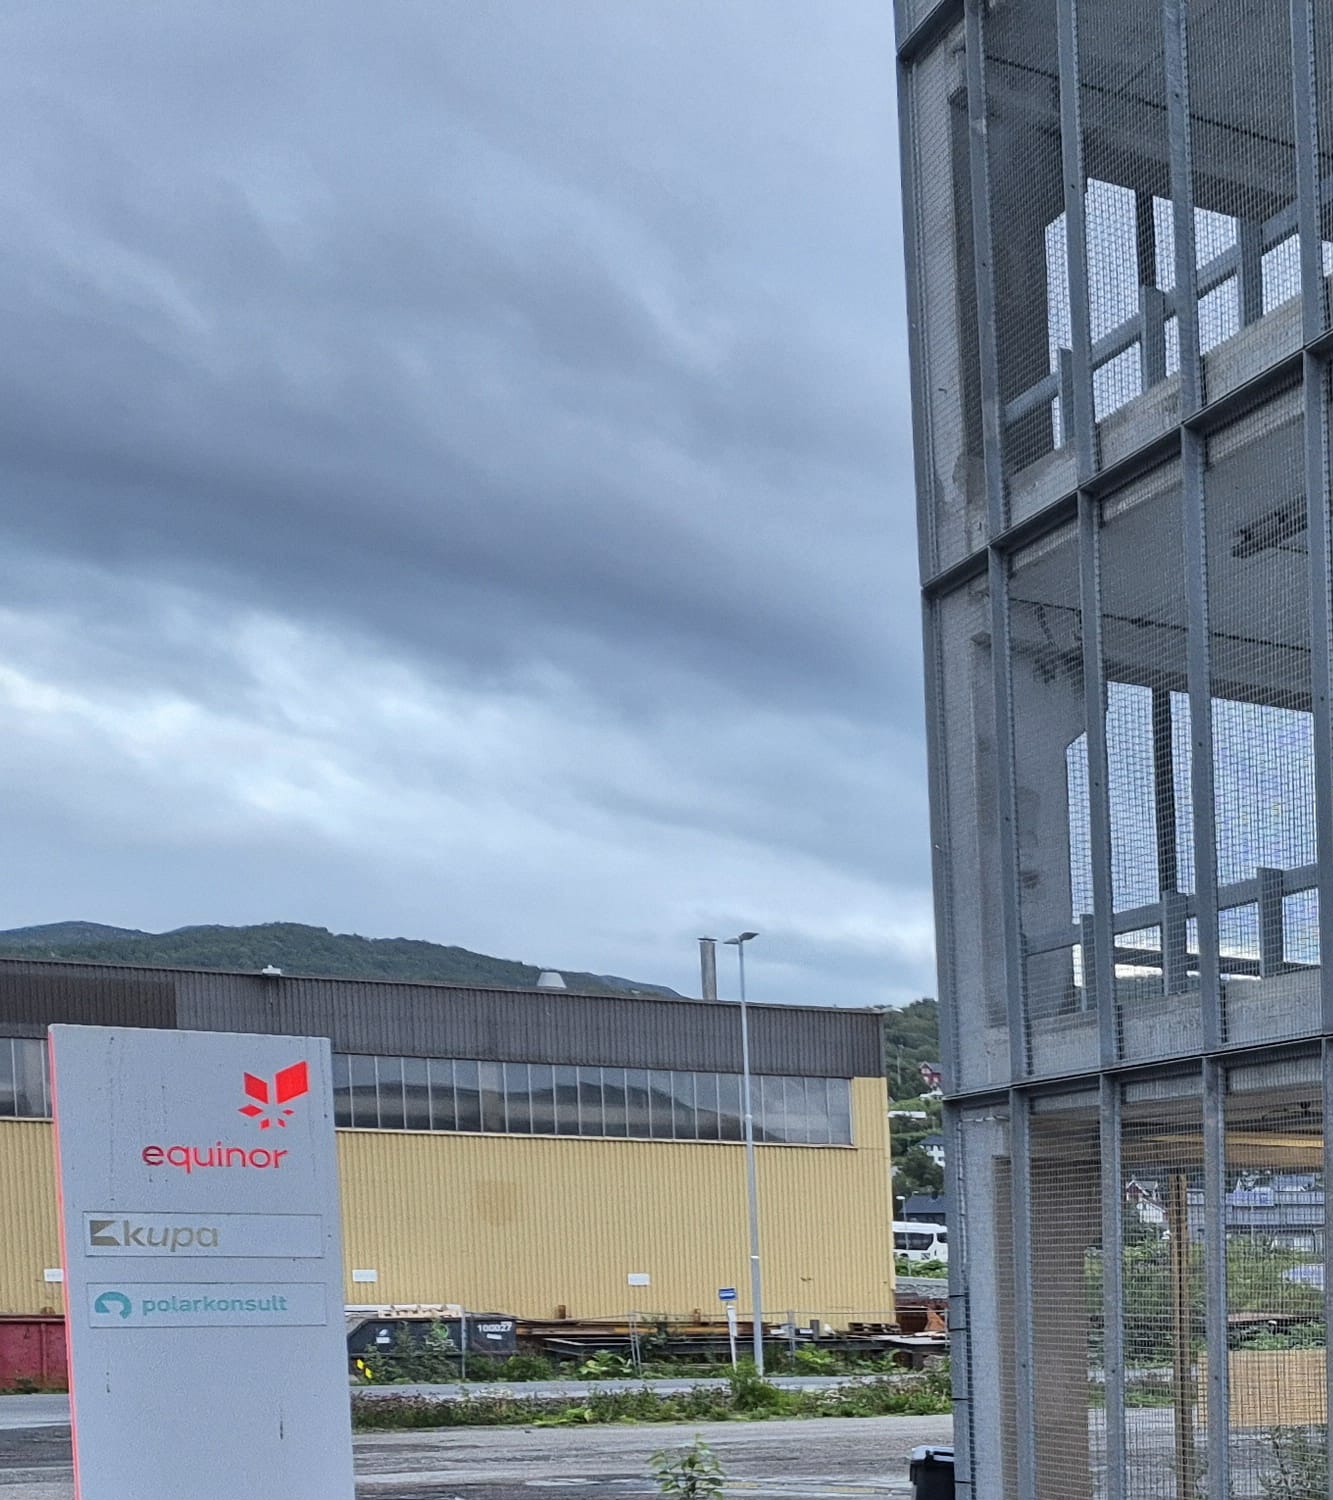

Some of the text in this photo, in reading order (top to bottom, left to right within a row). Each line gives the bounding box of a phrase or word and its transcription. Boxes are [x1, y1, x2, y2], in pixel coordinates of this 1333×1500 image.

[142, 1141, 289, 1175] equinor
[124, 1220, 220, 1252] kupa
[142, 1294, 289, 1317] polarkonsult
